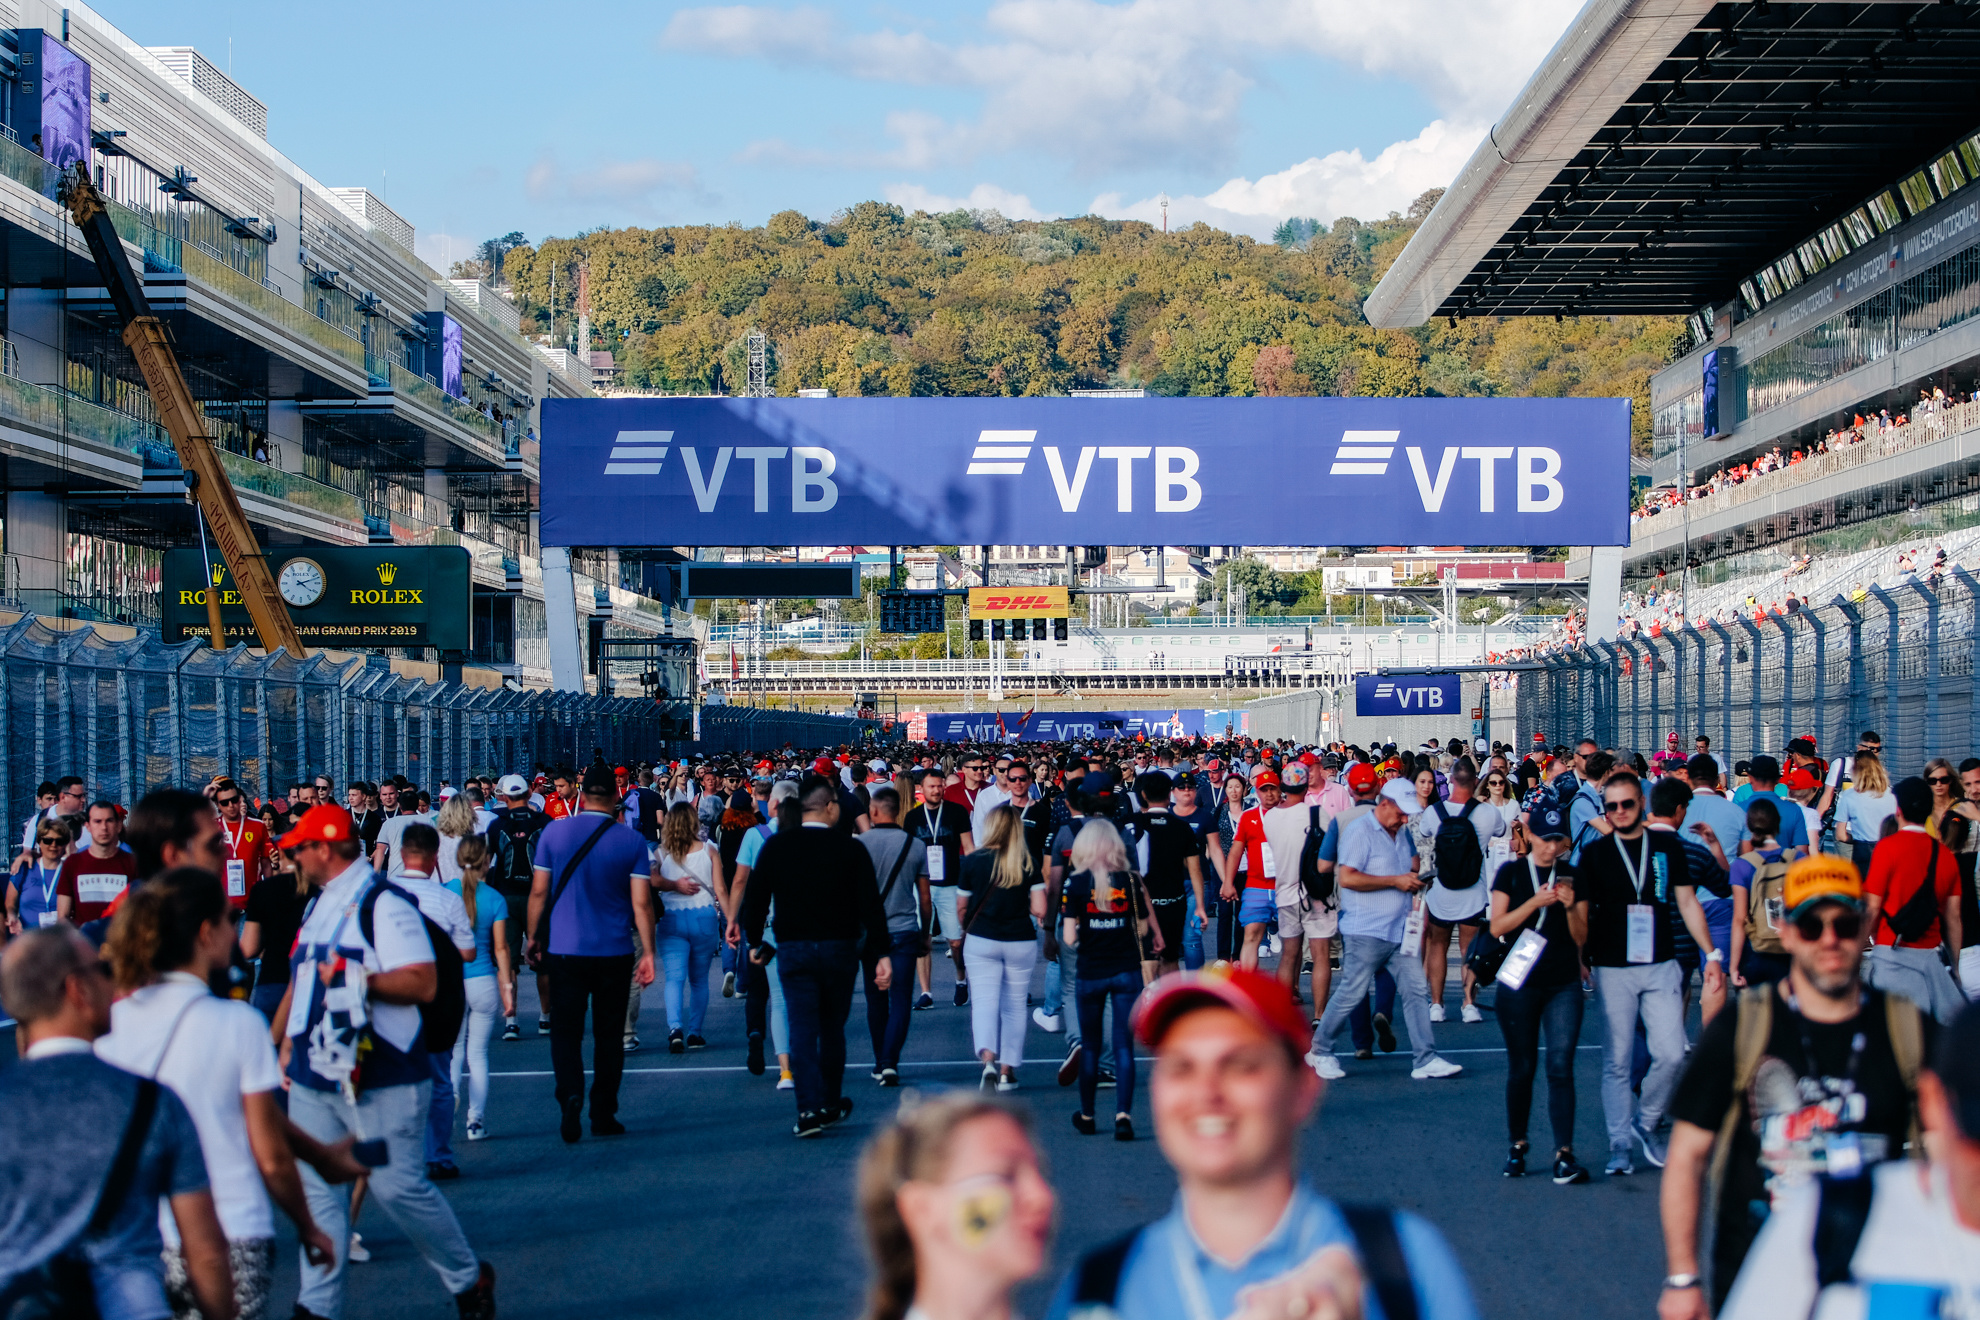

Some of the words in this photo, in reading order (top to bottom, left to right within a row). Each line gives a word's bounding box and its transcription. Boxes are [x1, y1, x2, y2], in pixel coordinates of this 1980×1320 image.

[1903, 201, 1979, 262] WWW.SOCHIAUTODROM.RU
[679, 446, 839, 513] VTB
[1043, 446, 1202, 513] VTB
[1405, 446, 1564, 513] VTB
[179, 590, 243, 605] ROE
[350, 589, 423, 604] ROLEX
[985, 596, 1052, 610] DHL
[183, 627, 237, 636] FORMLA
[321, 626, 361, 635] GRAND
[363, 626, 388, 635] PRIX
[390, 626, 417, 635] 2019
[1396, 687, 1444, 708] VTB
[1472, 710, 1481, 719] F
[1055, 723, 1096, 742] VTB
[1089, 918, 1116, 929] Mobil
[1119, 919, 1125, 927] 1
